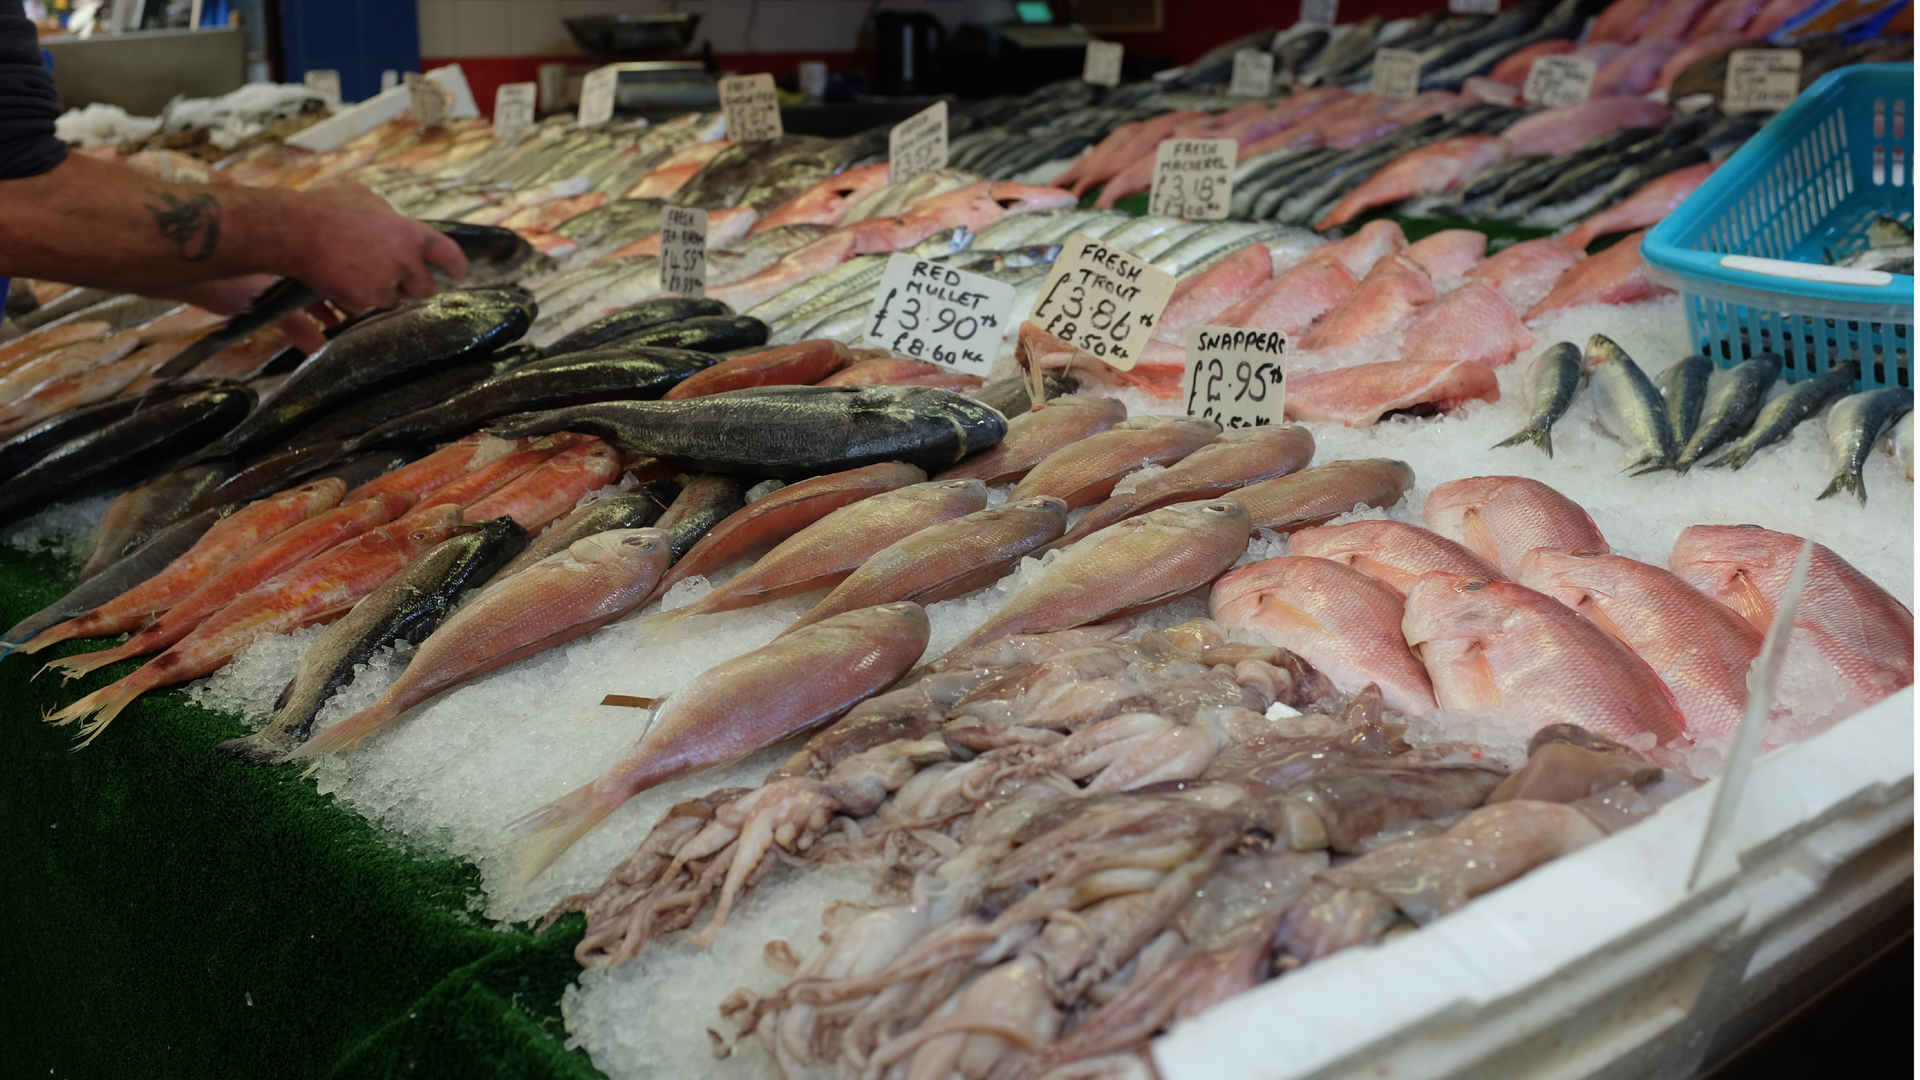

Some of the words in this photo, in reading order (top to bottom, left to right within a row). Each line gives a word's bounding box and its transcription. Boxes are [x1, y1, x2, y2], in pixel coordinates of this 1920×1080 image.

[1173, 142, 1218, 157] FRESH
[667, 209, 694, 227] FRESH
[912, 261, 961, 286] RED
[1079, 244, 1143, 283] FRESH
[906, 281, 990, 310] MULLET
[1079, 268, 1142, 302] TROUT
[892, 331, 957, 365] £8.60
[1045, 314, 1107, 357] £8.50
[1197, 330, 1286, 355] SNAPPERS
